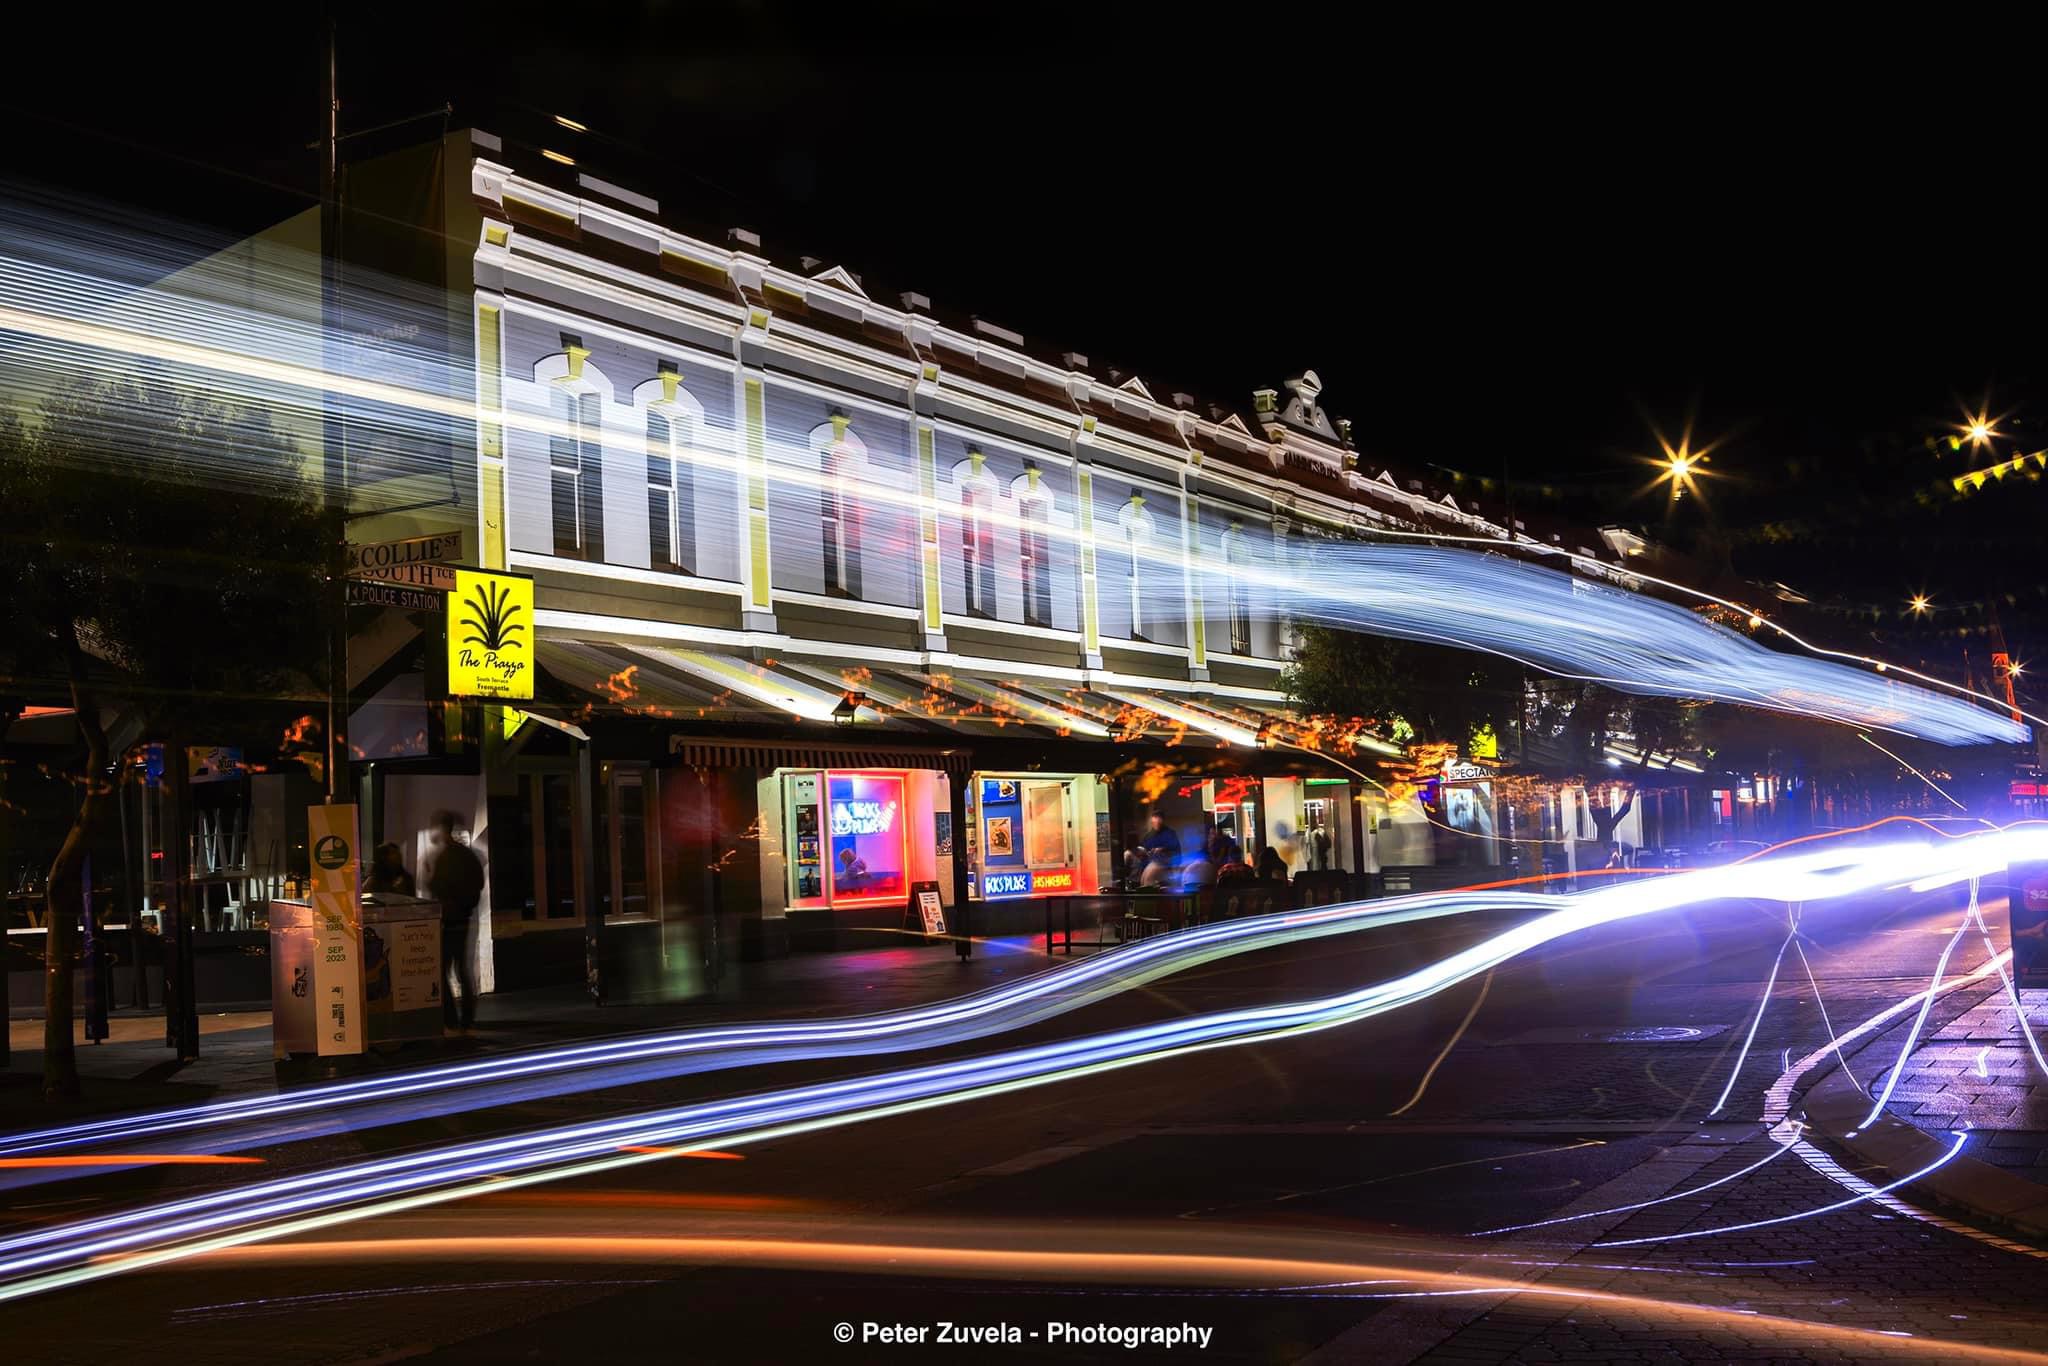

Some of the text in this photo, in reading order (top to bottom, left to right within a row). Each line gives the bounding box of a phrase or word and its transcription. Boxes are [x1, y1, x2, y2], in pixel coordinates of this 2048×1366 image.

[361, 535, 458, 568] COLLIE ST
[435, 568, 455, 579] TCE
[361, 586, 440, 610] POLICE STATION
[459, 649, 525, 679] The Piazza
[477, 683, 509, 691] Fremantle
[326, 954, 346, 962] 2023
